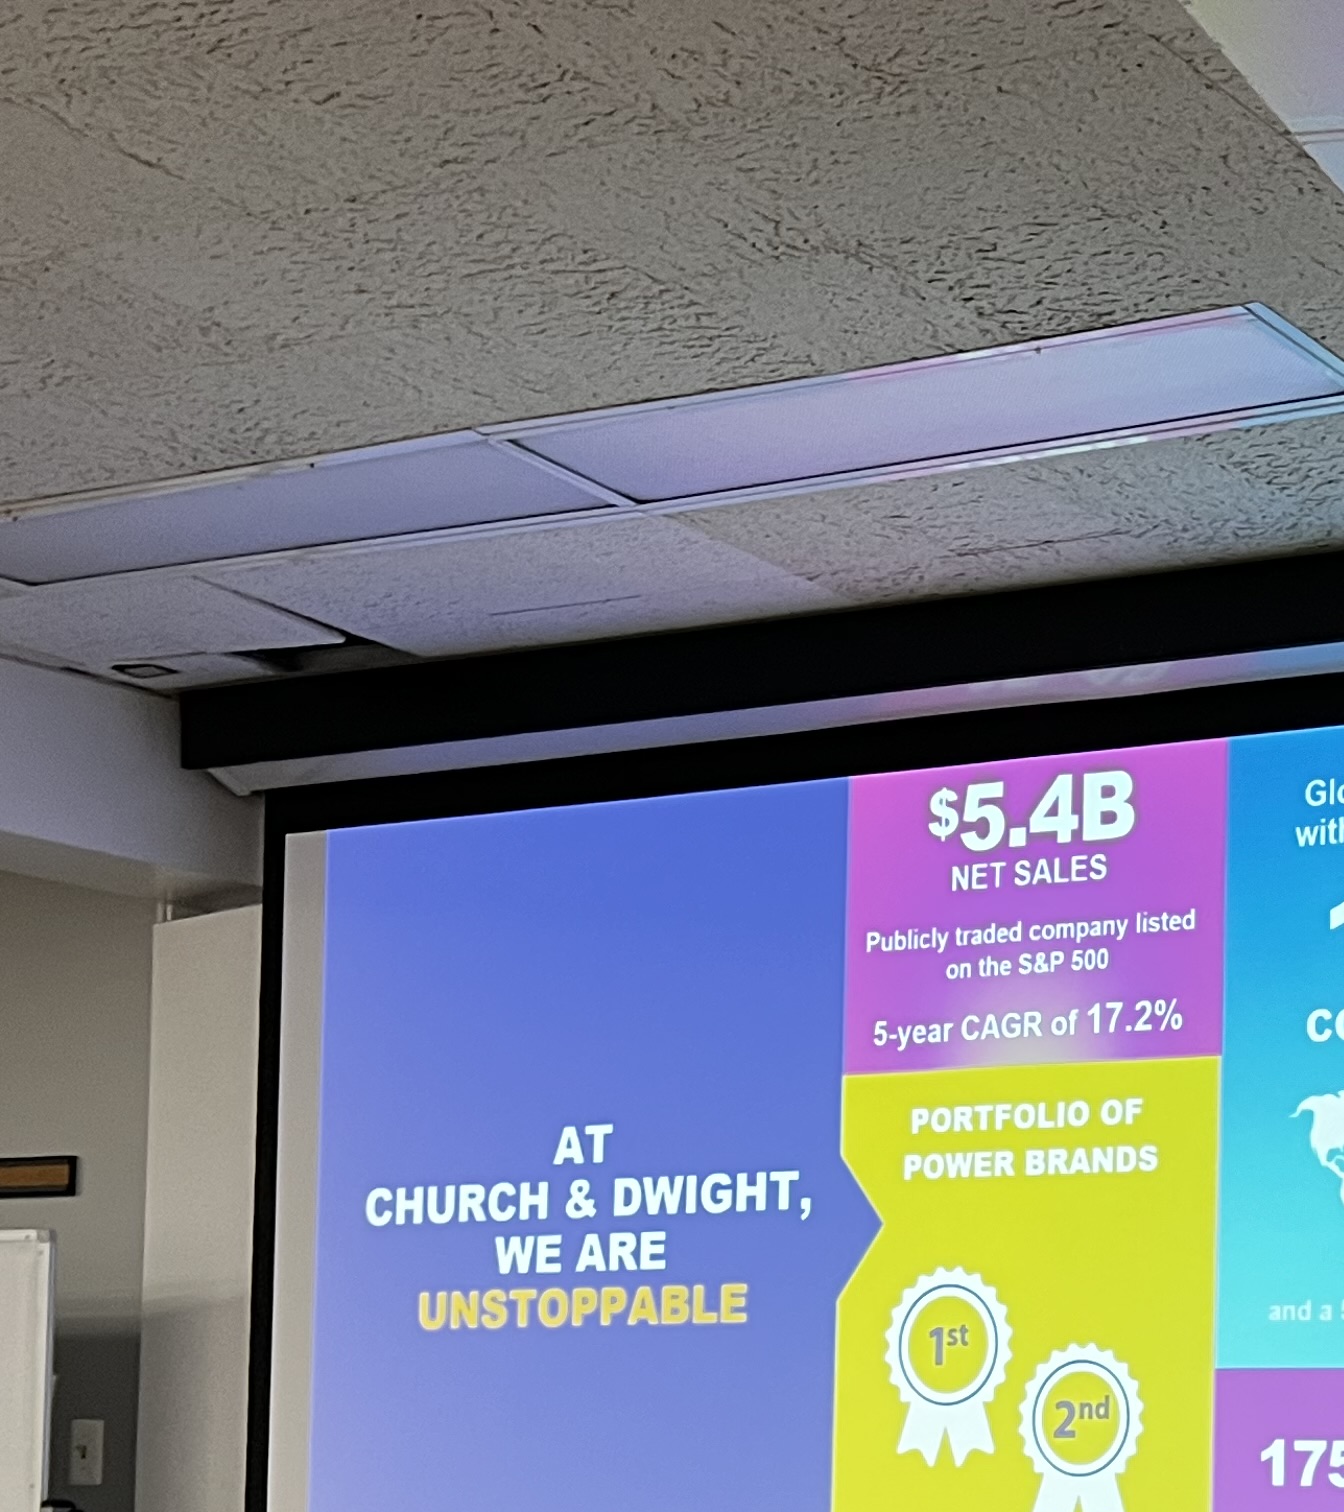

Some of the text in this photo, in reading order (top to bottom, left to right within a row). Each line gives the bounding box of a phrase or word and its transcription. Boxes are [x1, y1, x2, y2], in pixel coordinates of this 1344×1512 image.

[927, 768, 1136, 852] $5.4B
[950, 854, 1108, 892] NET SALES
[865, 908, 1196, 954] Publicly traded company listed
[945, 947, 1110, 980] on the S&P 500
[873, 998, 1183, 1052] 5-year CAGR of 17.2%
[911, 1098, 1144, 1135] PORTFOLIO OF
[552, 1123, 614, 1165] AT
[903, 1145, 1158, 1181] POWER BRANDS
[365, 1170, 812, 1227] CHURCH & DWIGHT,
[495, 1231, 667, 1274] WE ARE
[418, 1283, 748, 1331] UNSTOPPABLE
[1268, 1299, 1312, 1322] and
[1319, 1304, 1333, 1321] a
[928, 1323, 969, 1366] 1st
[1052, 1395, 1110, 1438] 2nd
